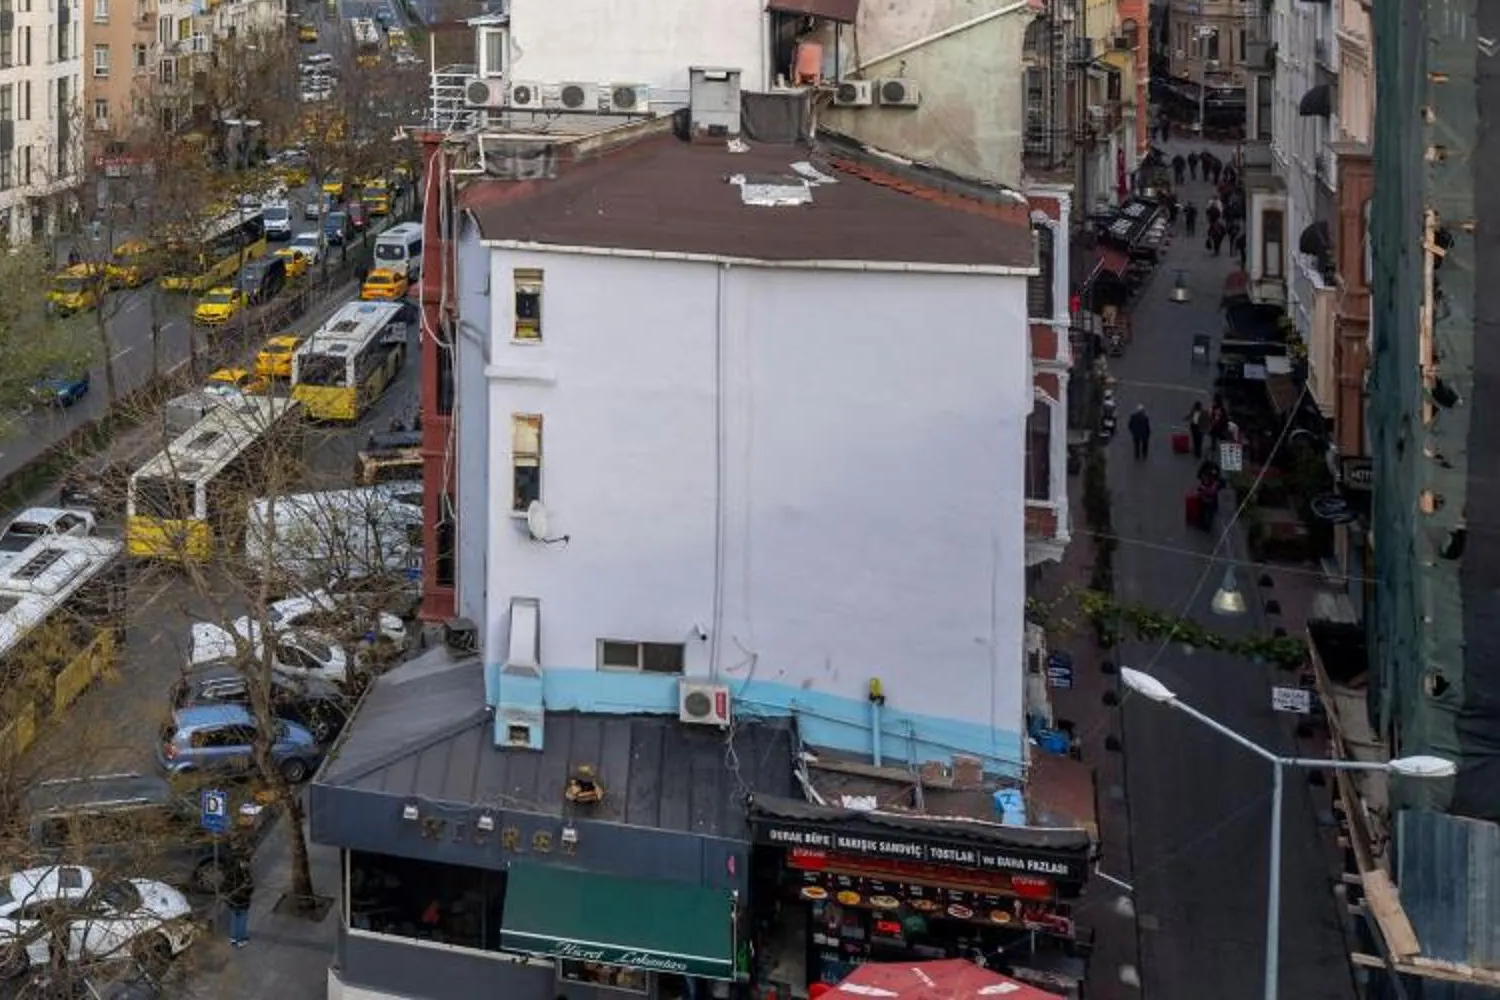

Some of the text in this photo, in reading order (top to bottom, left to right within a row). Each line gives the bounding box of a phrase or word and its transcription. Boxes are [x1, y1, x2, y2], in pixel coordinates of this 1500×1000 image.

[879, 841, 923, 859] SANDVİÇ
[930, 846, 975, 863] TOSTLAR
[997, 854, 1025, 869] DAHA
[1027, 859, 1069, 875] FAZLASI
